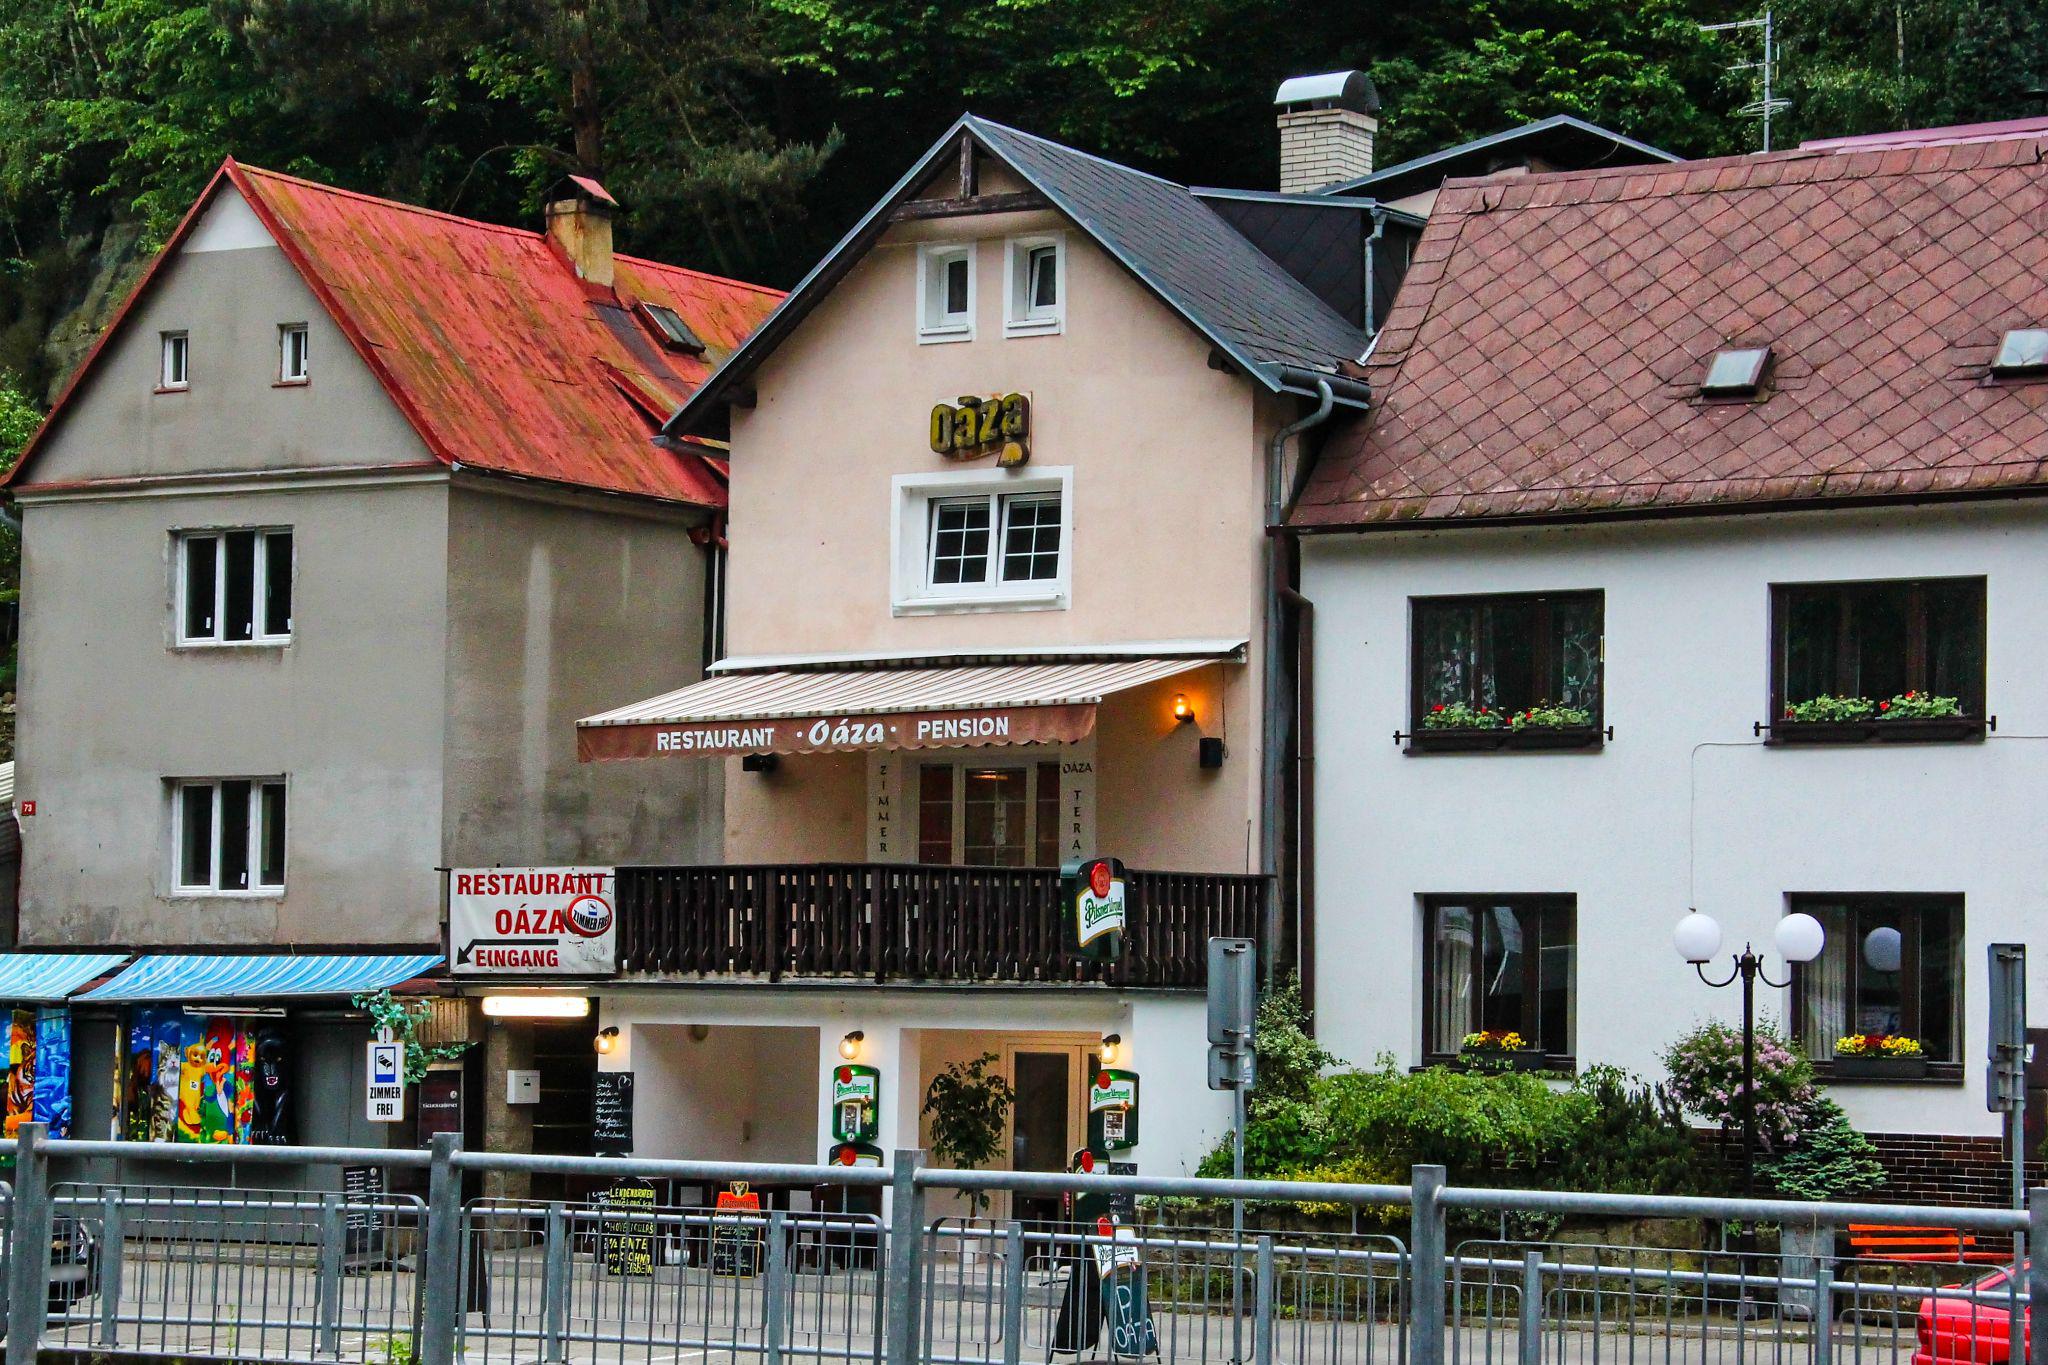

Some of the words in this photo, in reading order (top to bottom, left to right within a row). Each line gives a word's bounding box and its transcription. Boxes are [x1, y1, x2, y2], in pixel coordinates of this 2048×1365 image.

[656, 727, 775, 751] RESTAURANT
[808, 718, 884, 746] Oáza
[917, 716, 1009, 740] PENSION
[878, 765, 889, 853] ZIMMER
[1072, 790, 1082, 859] TERA
[457, 873, 607, 895] RESTAURANT
[495, 903, 566, 935] OÁZA
[573, 909, 598, 931] ZIMMER
[475, 949, 560, 967] EINGANG
[369, 1086, 401, 1100] ZIMMER
[376, 1103, 393, 1116] FREI
